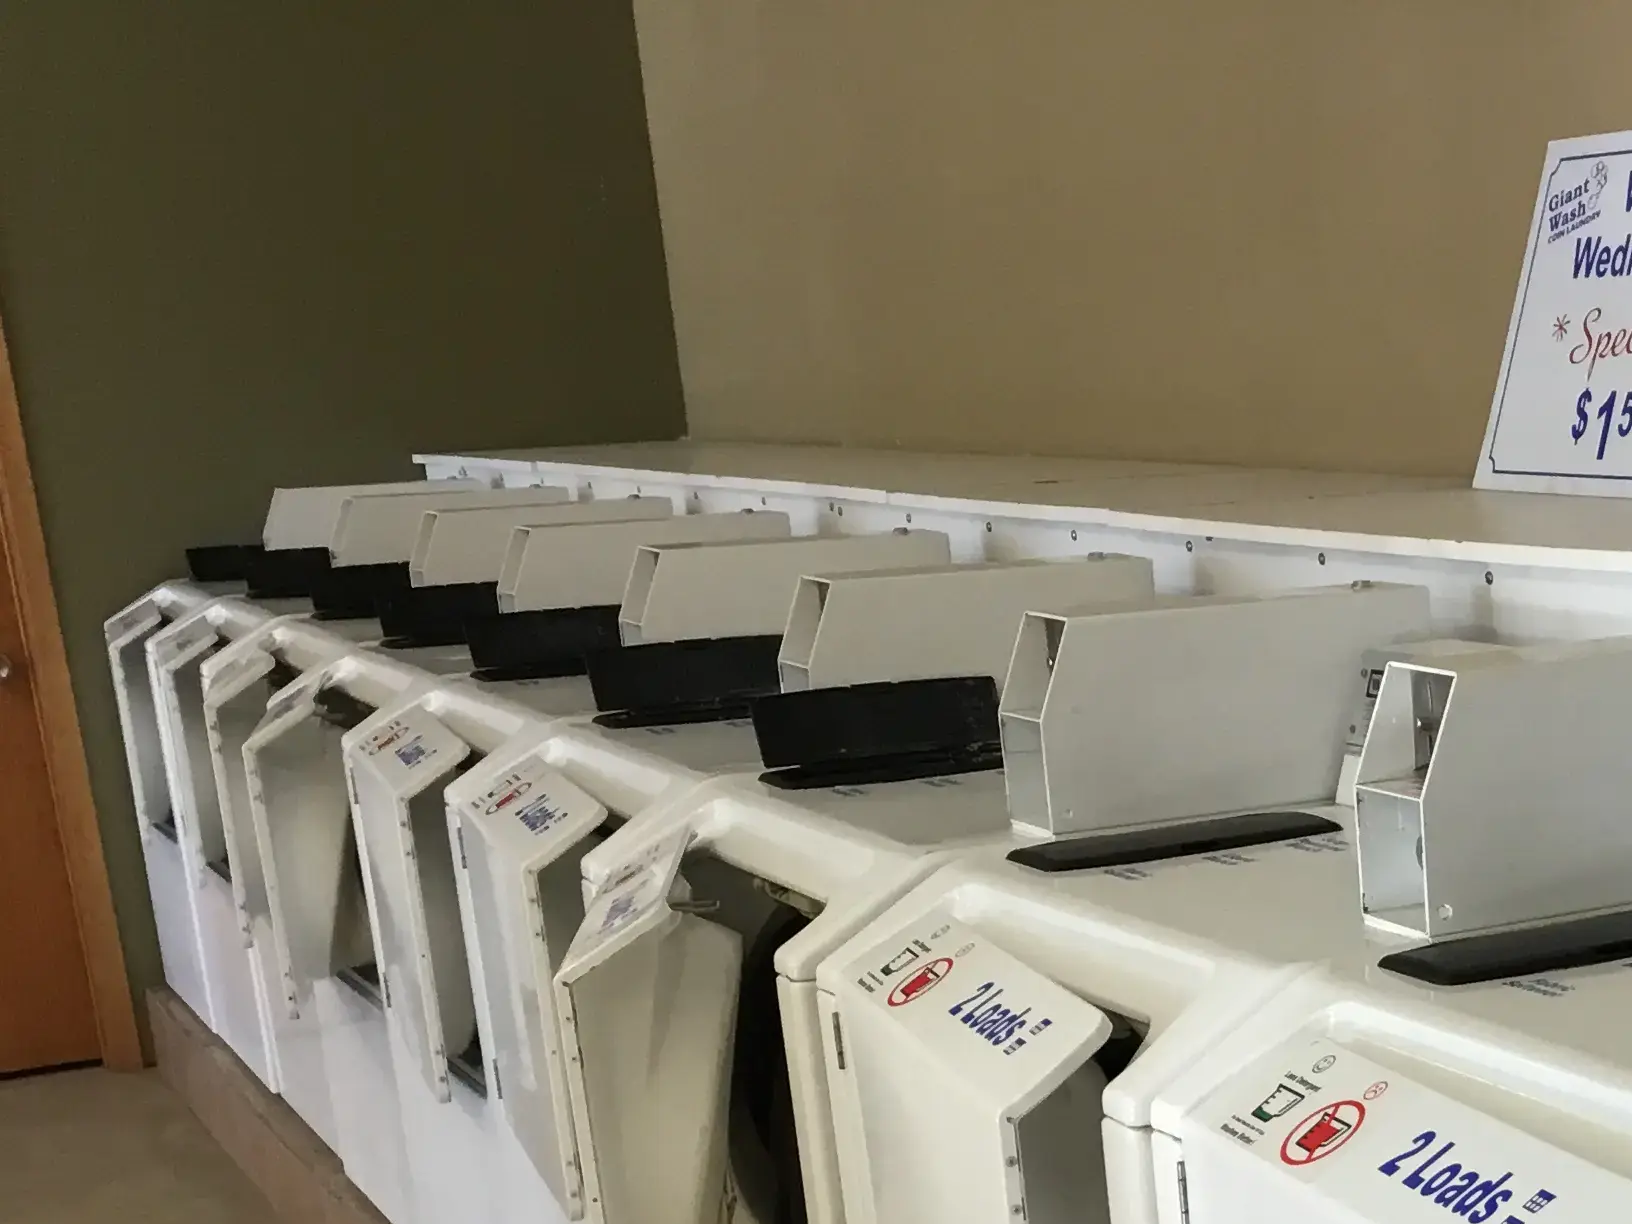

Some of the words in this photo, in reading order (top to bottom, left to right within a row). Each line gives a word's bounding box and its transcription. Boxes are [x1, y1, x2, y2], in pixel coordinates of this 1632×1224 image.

[1549, 178, 1590, 212] Giant
[1548, 229, 1565, 244] COIN
[1567, 209, 1601, 235] LAUNDRY
[1549, 200, 1586, 232] Wash
[948, 982, 995, 1016] 2
[961, 988, 1032, 1046] Loads
[1377, 1130, 1436, 1177] 2
[1401, 1141, 1514, 1224] Loads
